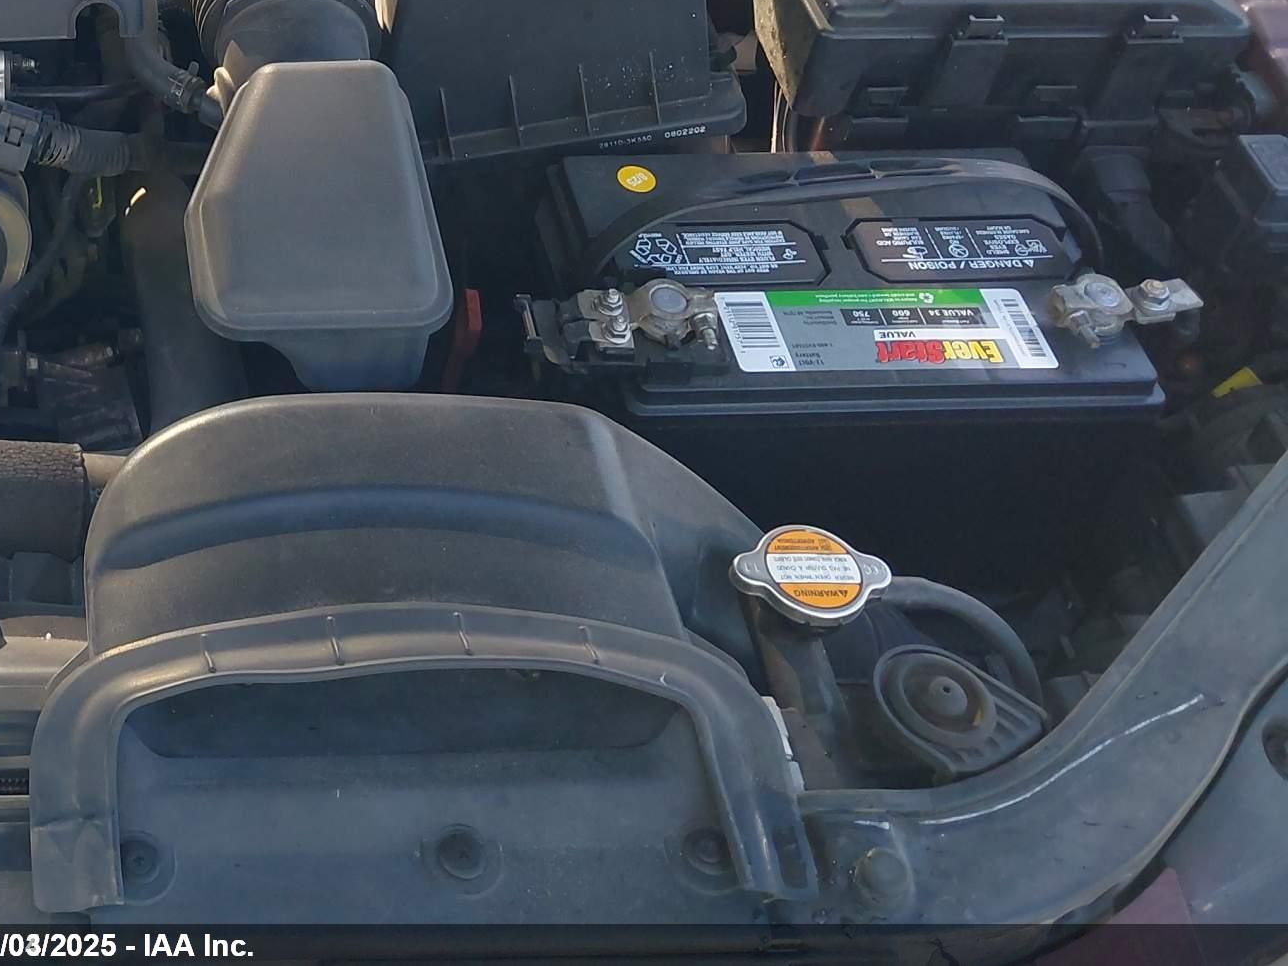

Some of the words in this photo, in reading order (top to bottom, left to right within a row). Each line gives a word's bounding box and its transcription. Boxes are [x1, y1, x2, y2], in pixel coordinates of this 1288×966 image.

[908, 261, 957, 271] POISON
[970, 259, 1024, 270] DANGER
[891, 309, 911, 317] 600
[943, 309, 975, 317] VALUE
[880, 330, 916, 339] VALUE
[876, 339, 1005, 364] EverStart
[793, 589, 839, 598] WARNING
